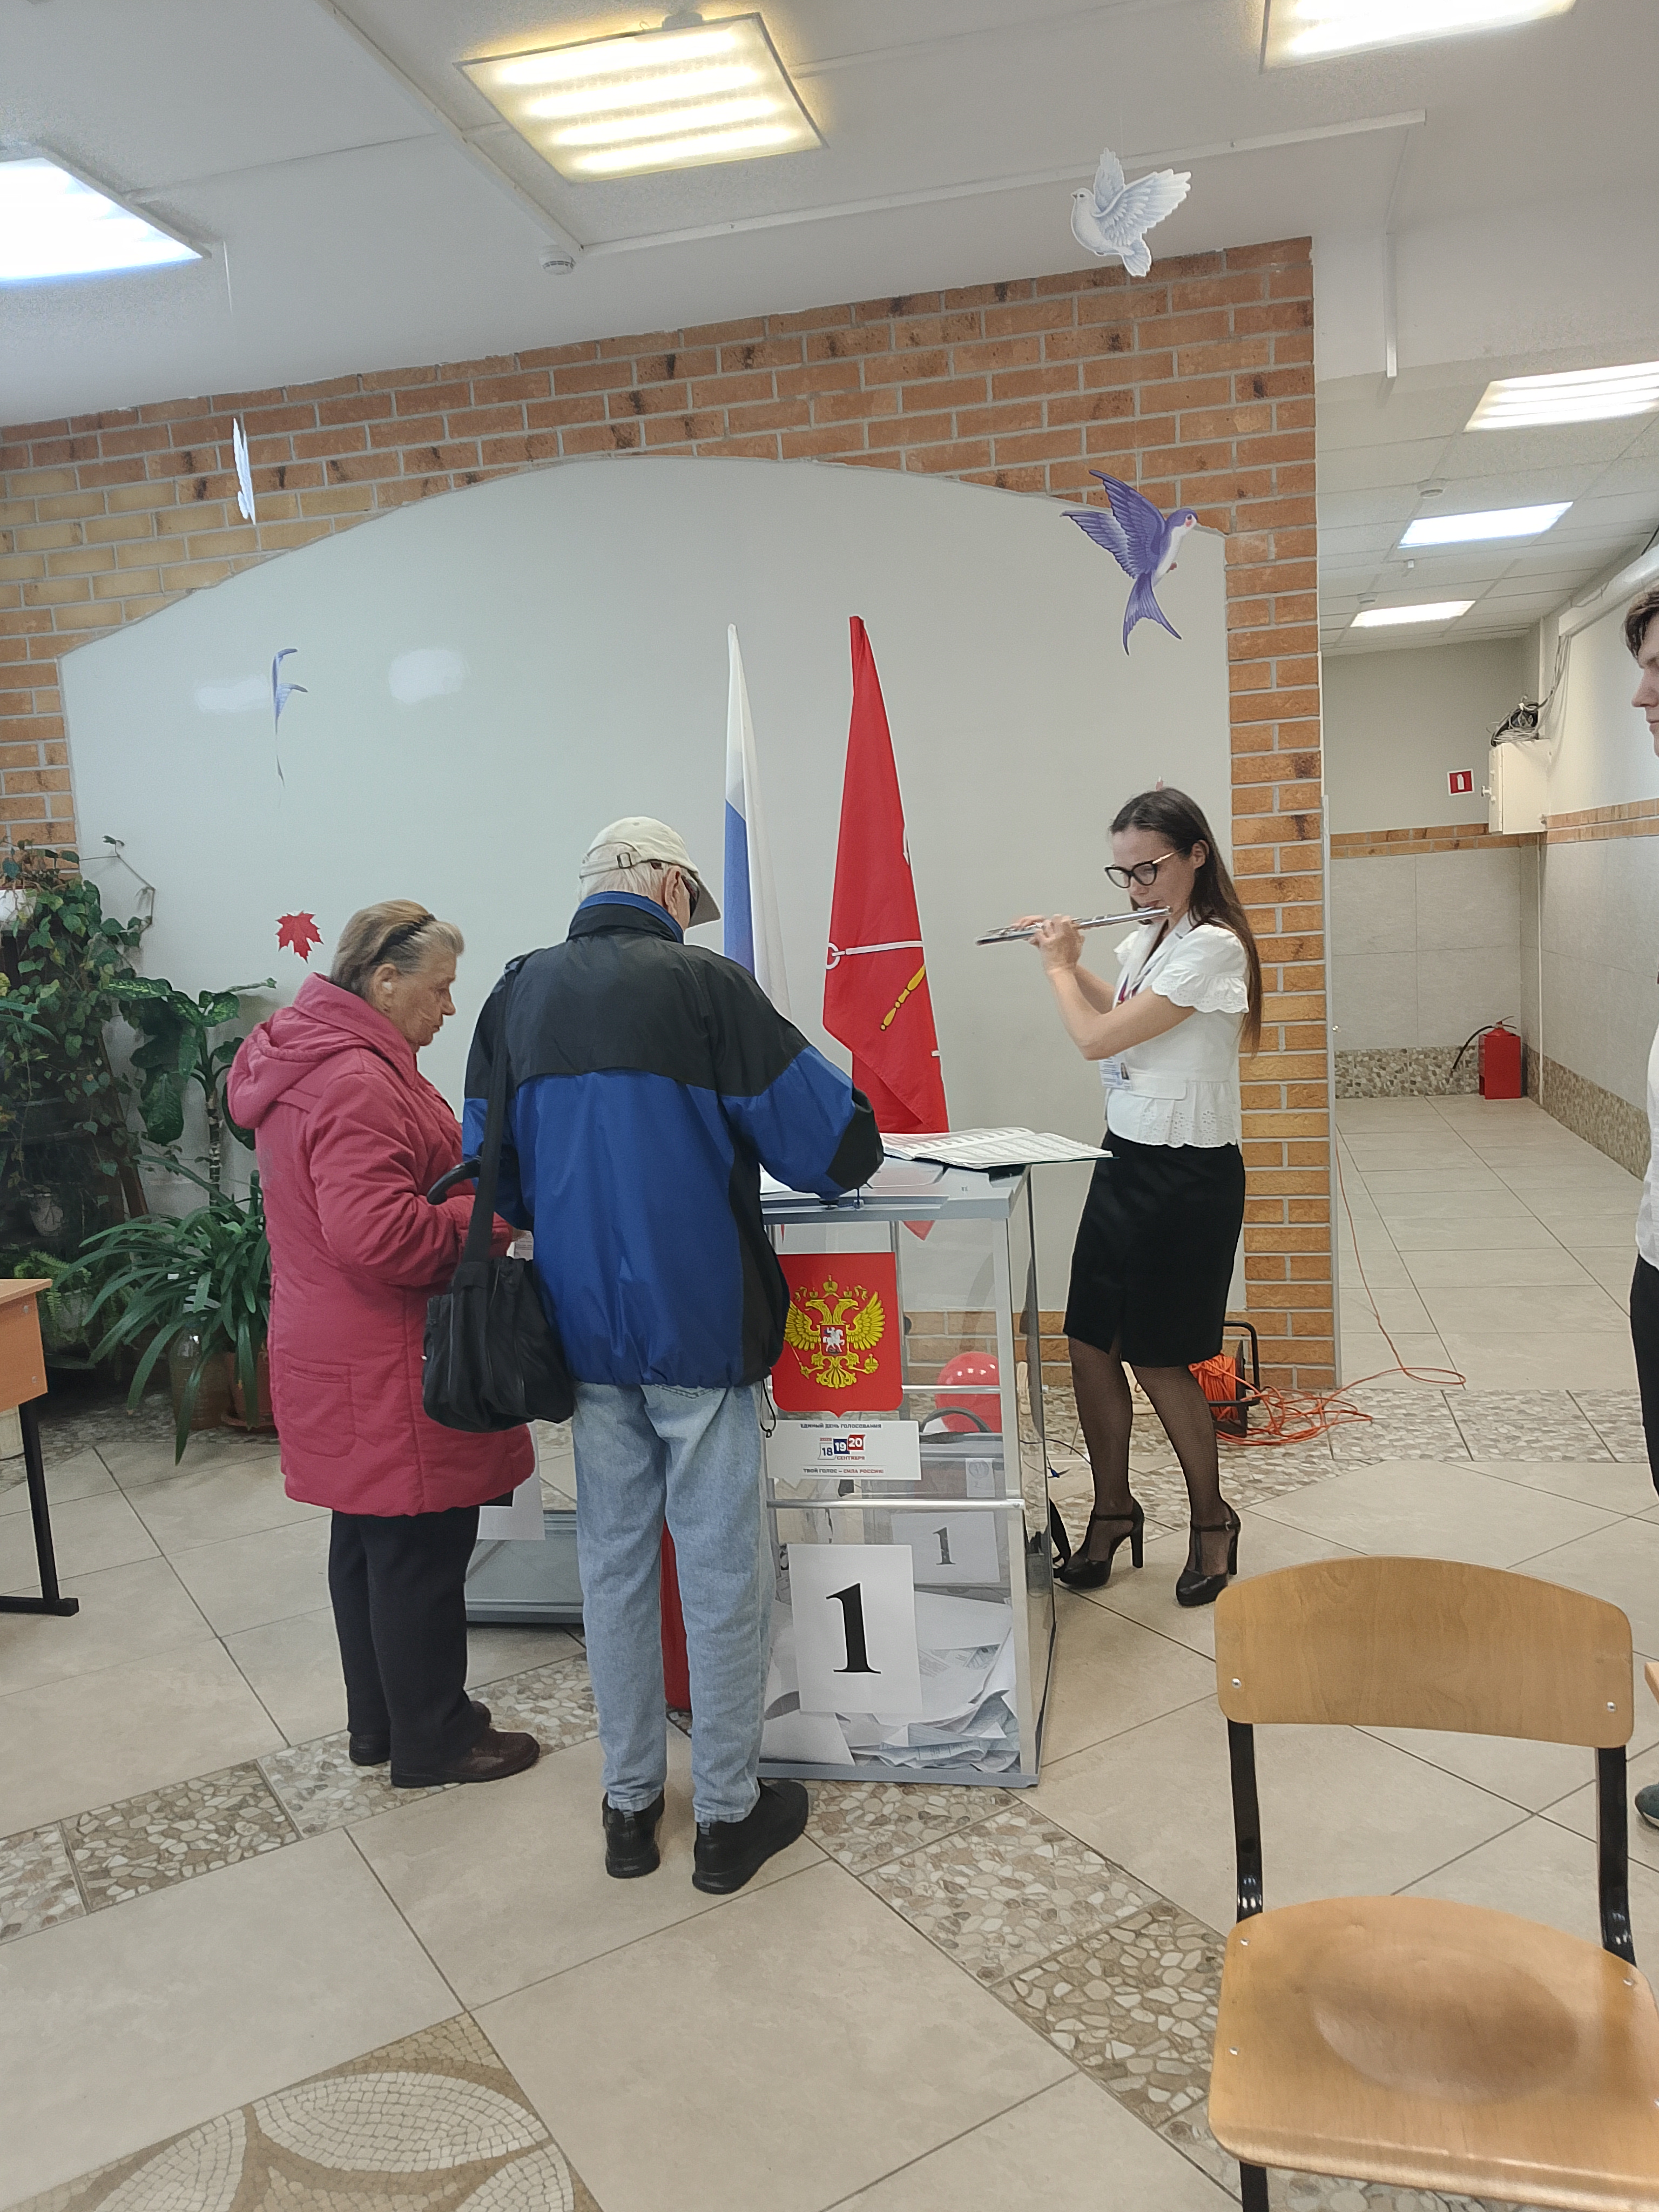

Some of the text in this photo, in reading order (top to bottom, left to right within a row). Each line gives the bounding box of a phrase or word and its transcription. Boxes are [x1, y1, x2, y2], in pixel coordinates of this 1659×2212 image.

[821, 1438, 862, 1456] 18 19 20
[932, 1527, 956, 1565] 1
[826, 1583, 881, 1674] 1
